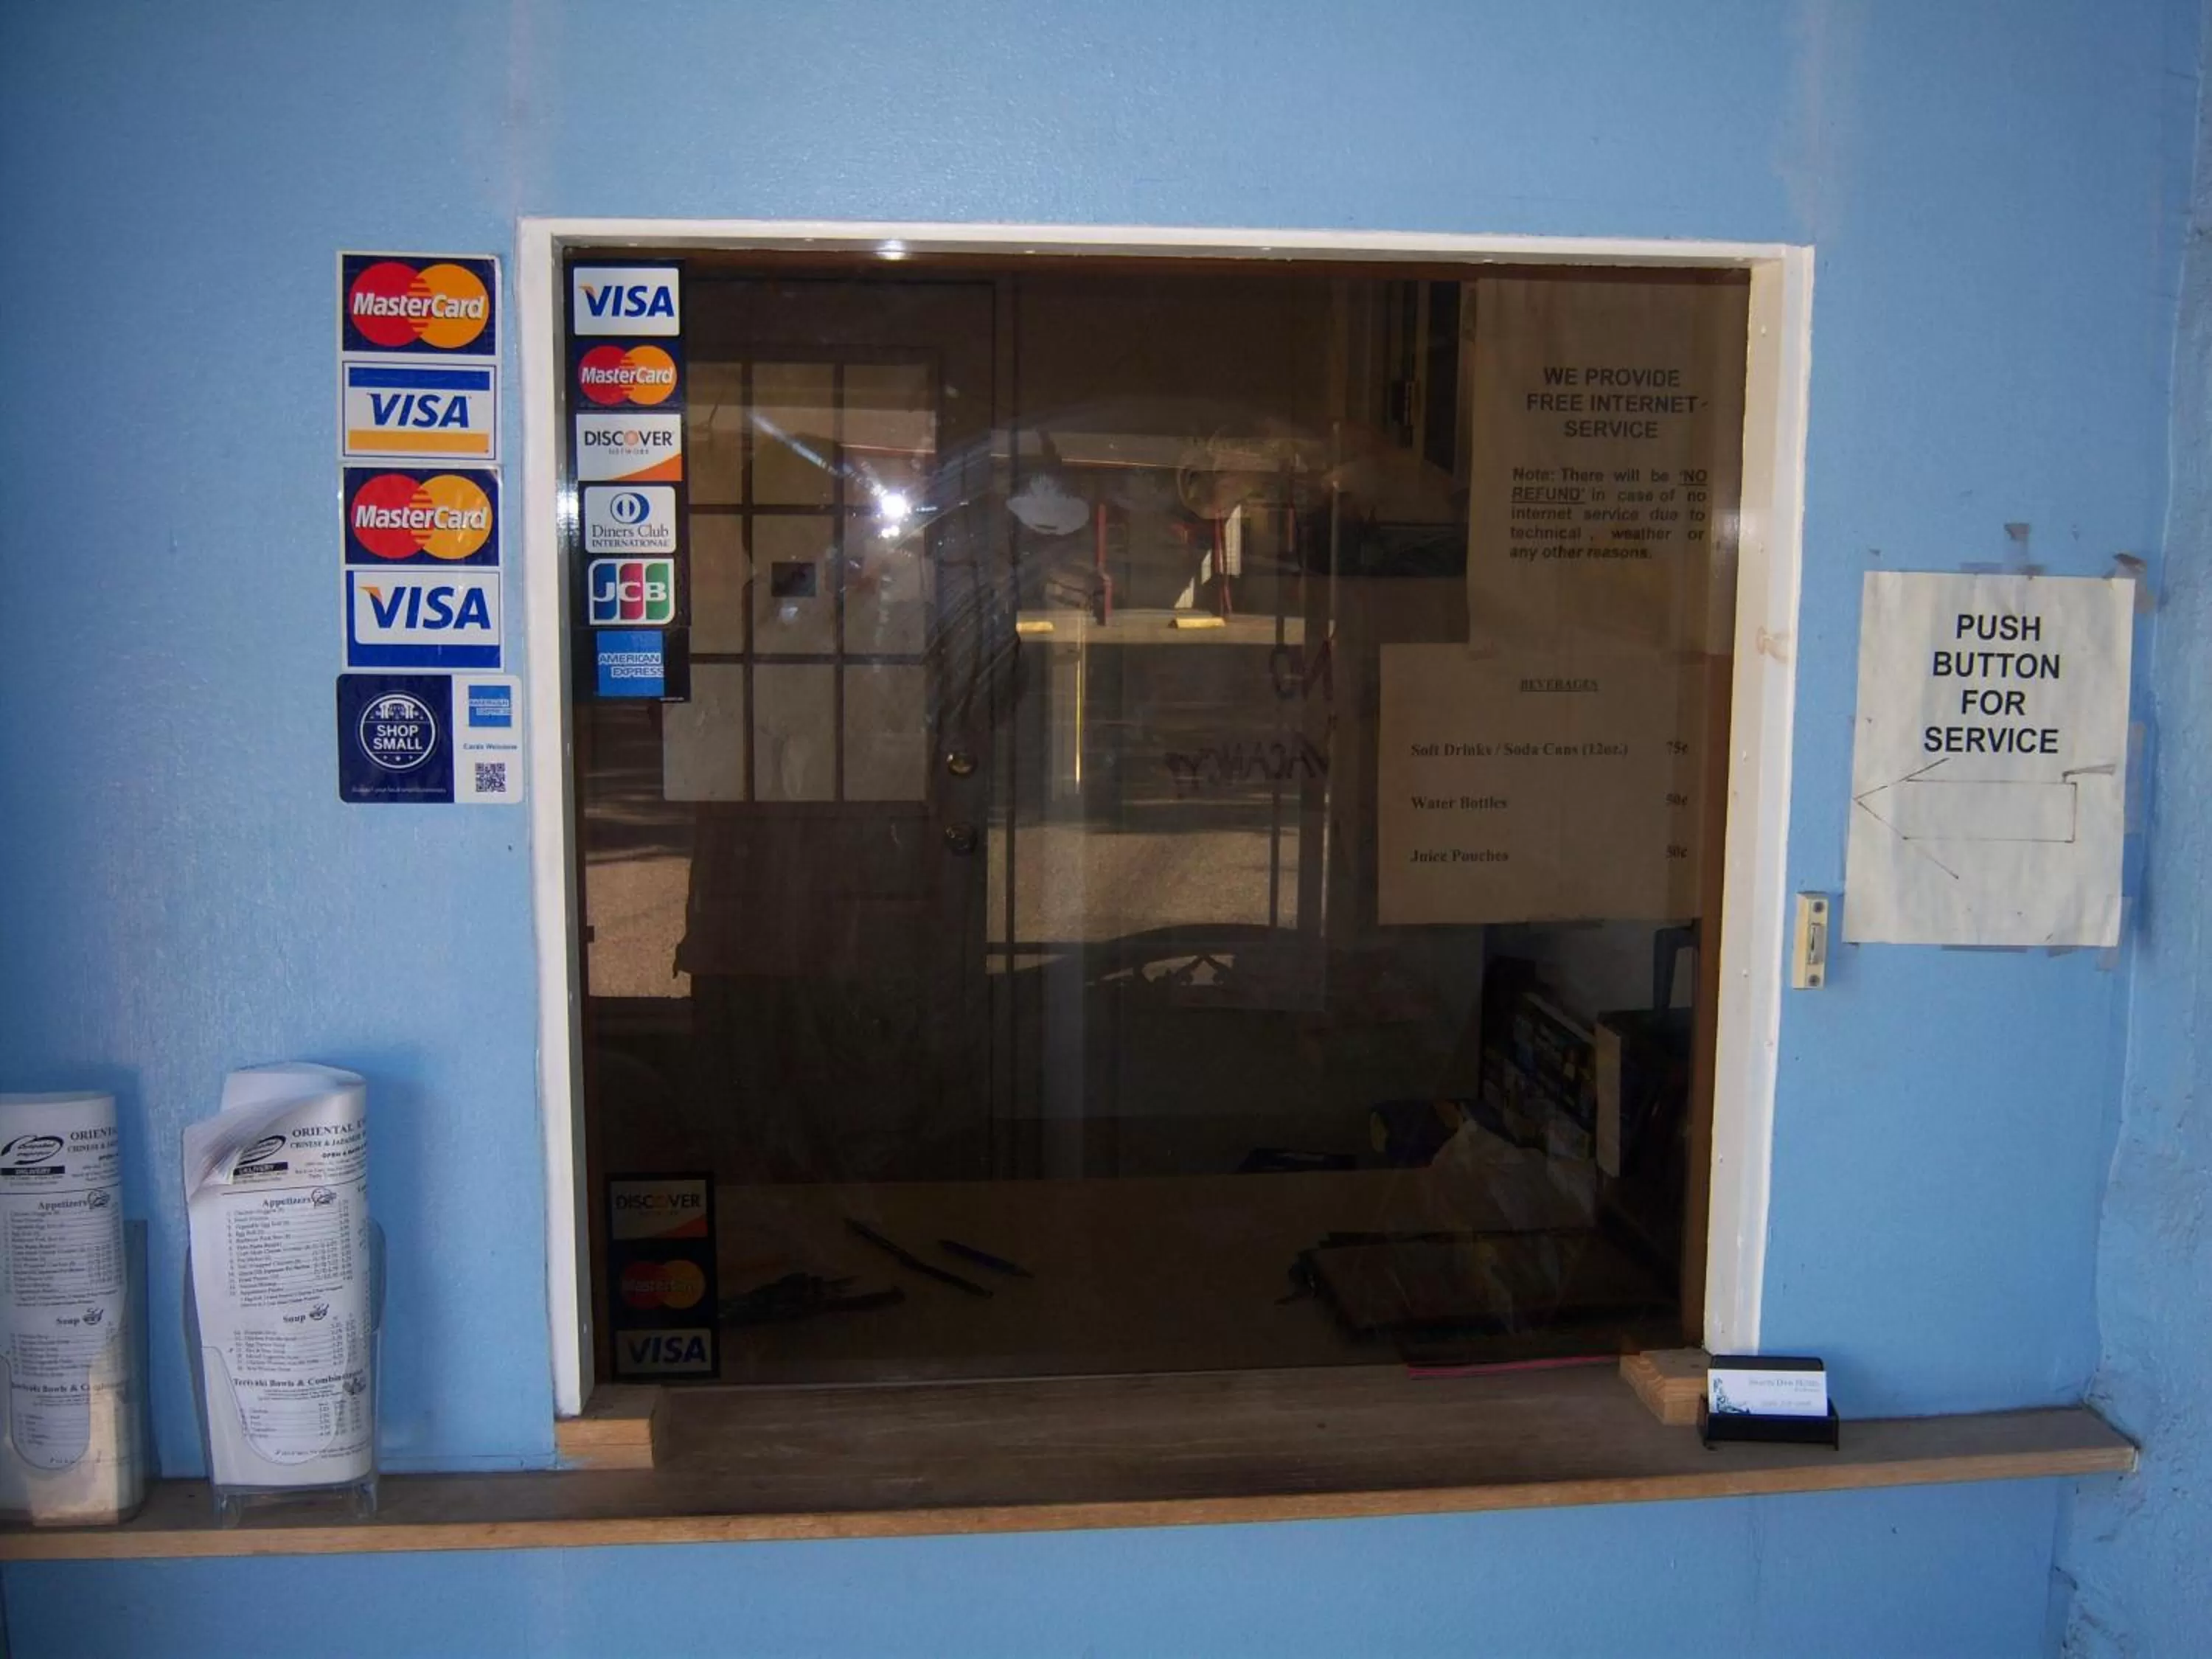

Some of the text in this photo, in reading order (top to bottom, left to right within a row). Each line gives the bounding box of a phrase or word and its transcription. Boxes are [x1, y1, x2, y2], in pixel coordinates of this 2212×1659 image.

[353, 293, 485, 320] MasterCard
[580, 285, 674, 317] VISA
[581, 366, 674, 385] MasterCard
[1543, 368, 1680, 387] WE PROVIDE
[369, 393, 469, 428] VISA
[1527, 394, 1698, 413] FREE INTERNET
[1565, 421, 1658, 439] SERVICE
[584, 430, 672, 446] DISCOVER
[1512, 467, 1555, 481] Note:
[1561, 467, 1604, 481] There
[1614, 469, 1639, 481] will
[1651, 469, 1669, 481] be
[1592, 487, 1604, 501] in
[1618, 490, 1653, 501] case
[1660, 489, 1674, 501] of
[1687, 489, 1706, 502] no
[355, 506, 487, 529] MasterCard
[1512, 507, 1705, 521] internet service due to
[592, 524, 668, 538] Diners Club
[1510, 526, 1581, 540] technical
[1612, 527, 1672, 540] weather
[1688, 529, 1704, 540] or
[592, 539, 669, 547] INTERNATIONAL
[1510, 547, 1537, 562] any
[1543, 546, 1583, 559] other
[592, 582, 667, 602] JCB
[359, 587, 490, 629] VISA
[1956, 614, 2040, 641] PUSH
[599, 654, 660, 663] AMERICAN
[1933, 651, 2059, 678] BUTTON
[612, 667, 664, 676] EXPRESS
[1961, 690, 2025, 715] FOR
[377, 725, 418, 737] SHOP
[374, 738, 422, 750] SMALL
[1924, 727, 2058, 754] SERVICE
[1411, 743, 1439, 756] Soft
[1444, 743, 1492, 756] Drinks
[1505, 743, 1538, 756] Soda
[1543, 743, 1578, 756] Cans
[1411, 796, 1506, 809] Water Bottles
[1410, 849, 1509, 862] Juice Pouches
[292, 1123, 355, 1138] ORIENTAL
[38, 1199, 87, 1211] Appetizers
[262, 1196, 311, 1207] Appetizers
[616, 1194, 700, 1209] DISCOVER
[56, 1318, 80, 1326] Soup
[283, 1315, 306, 1324] Soup
[627, 1336, 706, 1363] VISA
